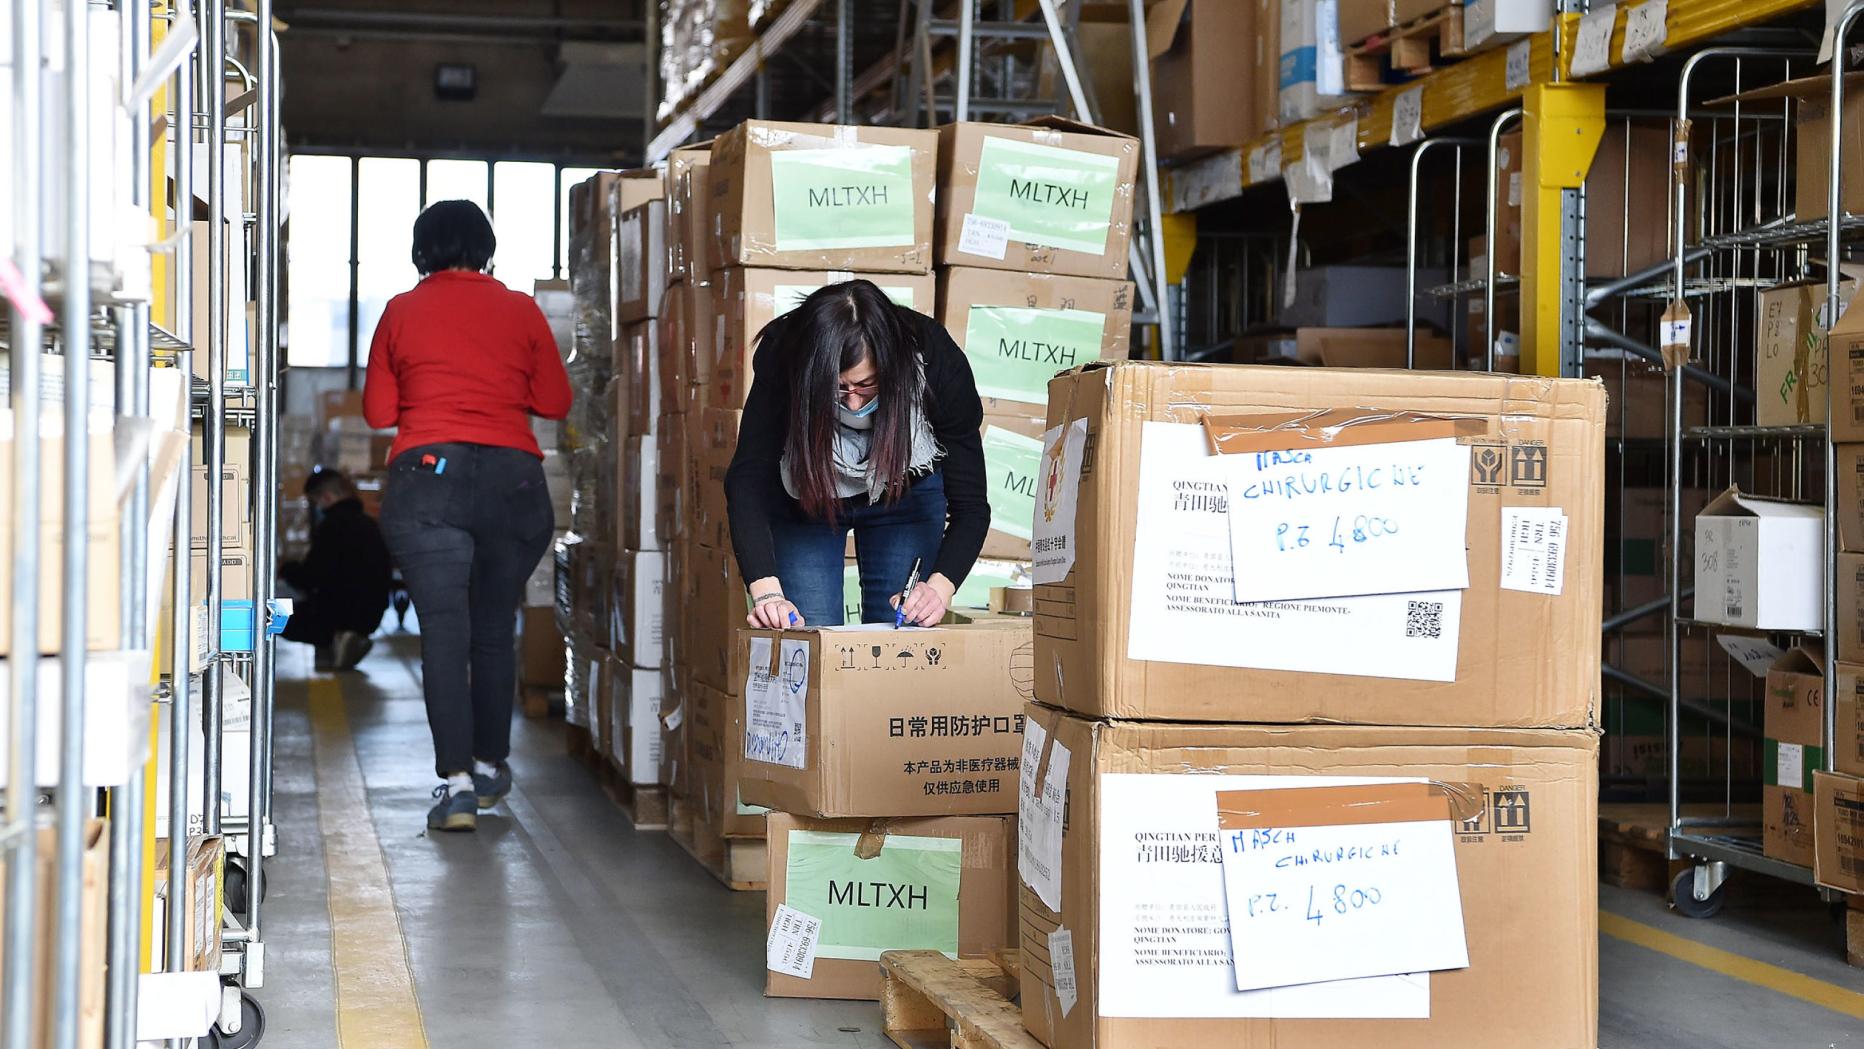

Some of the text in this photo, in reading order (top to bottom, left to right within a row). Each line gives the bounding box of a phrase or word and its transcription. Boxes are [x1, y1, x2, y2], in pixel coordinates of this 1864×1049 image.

[809, 185, 888, 207] MLTXH
[1010, 178, 1088, 210] MLTXH
[998, 337, 1076, 366] MLTXH
[1167, 572, 1192, 582] NOME
[1166, 582, 1209, 592] QINGTIAN
[1166, 594, 1191, 603] NOME
[1263, 601, 1302, 612] REGIONE
[1167, 604, 1225, 614] ASSESSORATO
[1227, 608, 1249, 617] ALLA
[904, 757, 1019, 775] 本产品为非医疗器械
[923, 779, 1000, 795] 仅供应急使用
[1135, 832, 1216, 843] QINGTIAN PER
[828, 880, 928, 910] MLTXH
[1306, 882, 1382, 926] 4800
[1134, 936, 1177, 944] QINGTIAN
[1135, 958, 1194, 966] ASSESSORATO
[1196, 958, 1218, 966] ALLA
